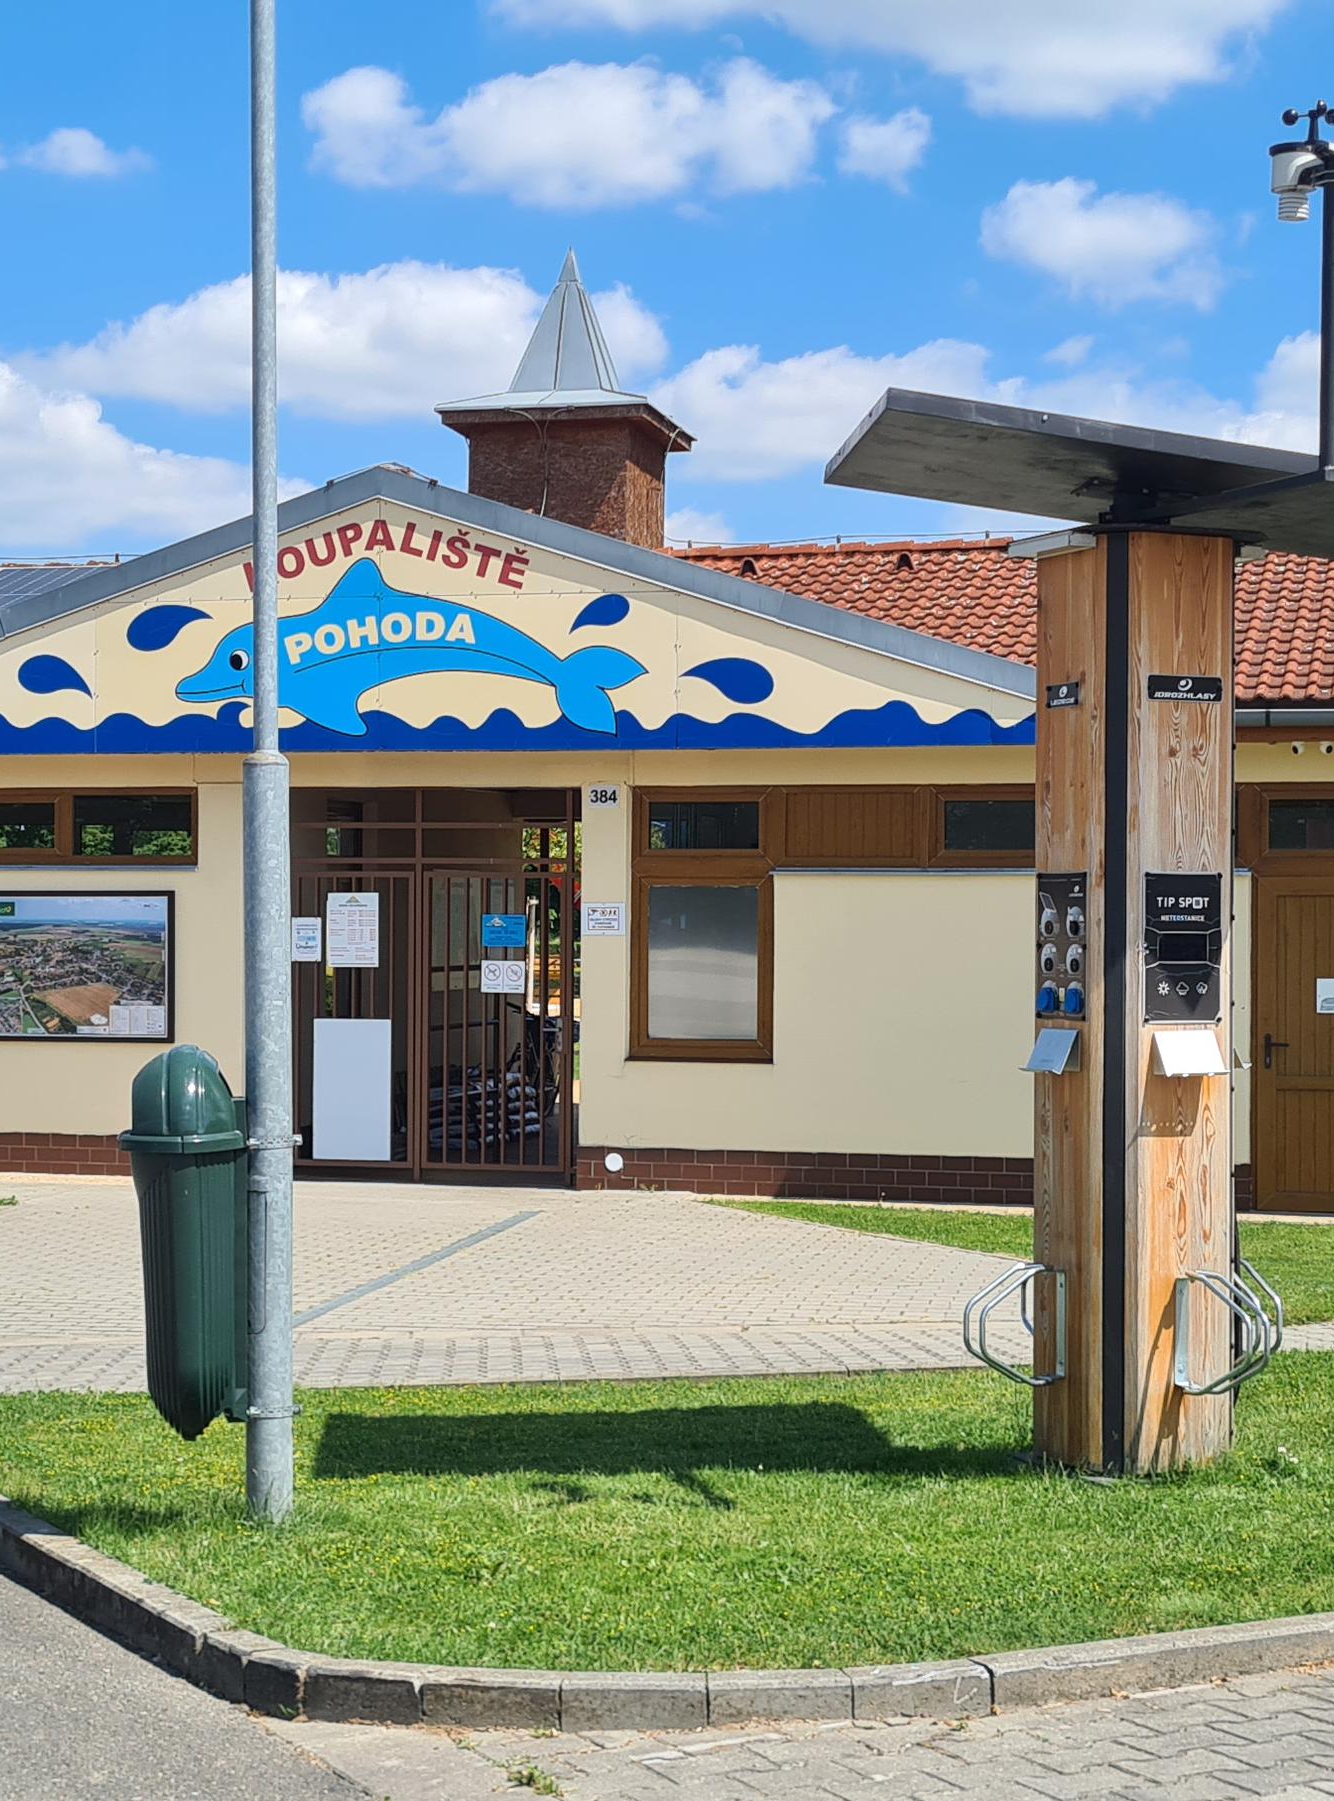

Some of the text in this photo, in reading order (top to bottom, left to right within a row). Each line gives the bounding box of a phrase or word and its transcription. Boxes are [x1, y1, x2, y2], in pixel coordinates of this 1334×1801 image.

[283, 611, 476, 665] POHODA
[590, 789, 618, 804] 384
[1156, 896, 1210, 909] TIP SPOT
